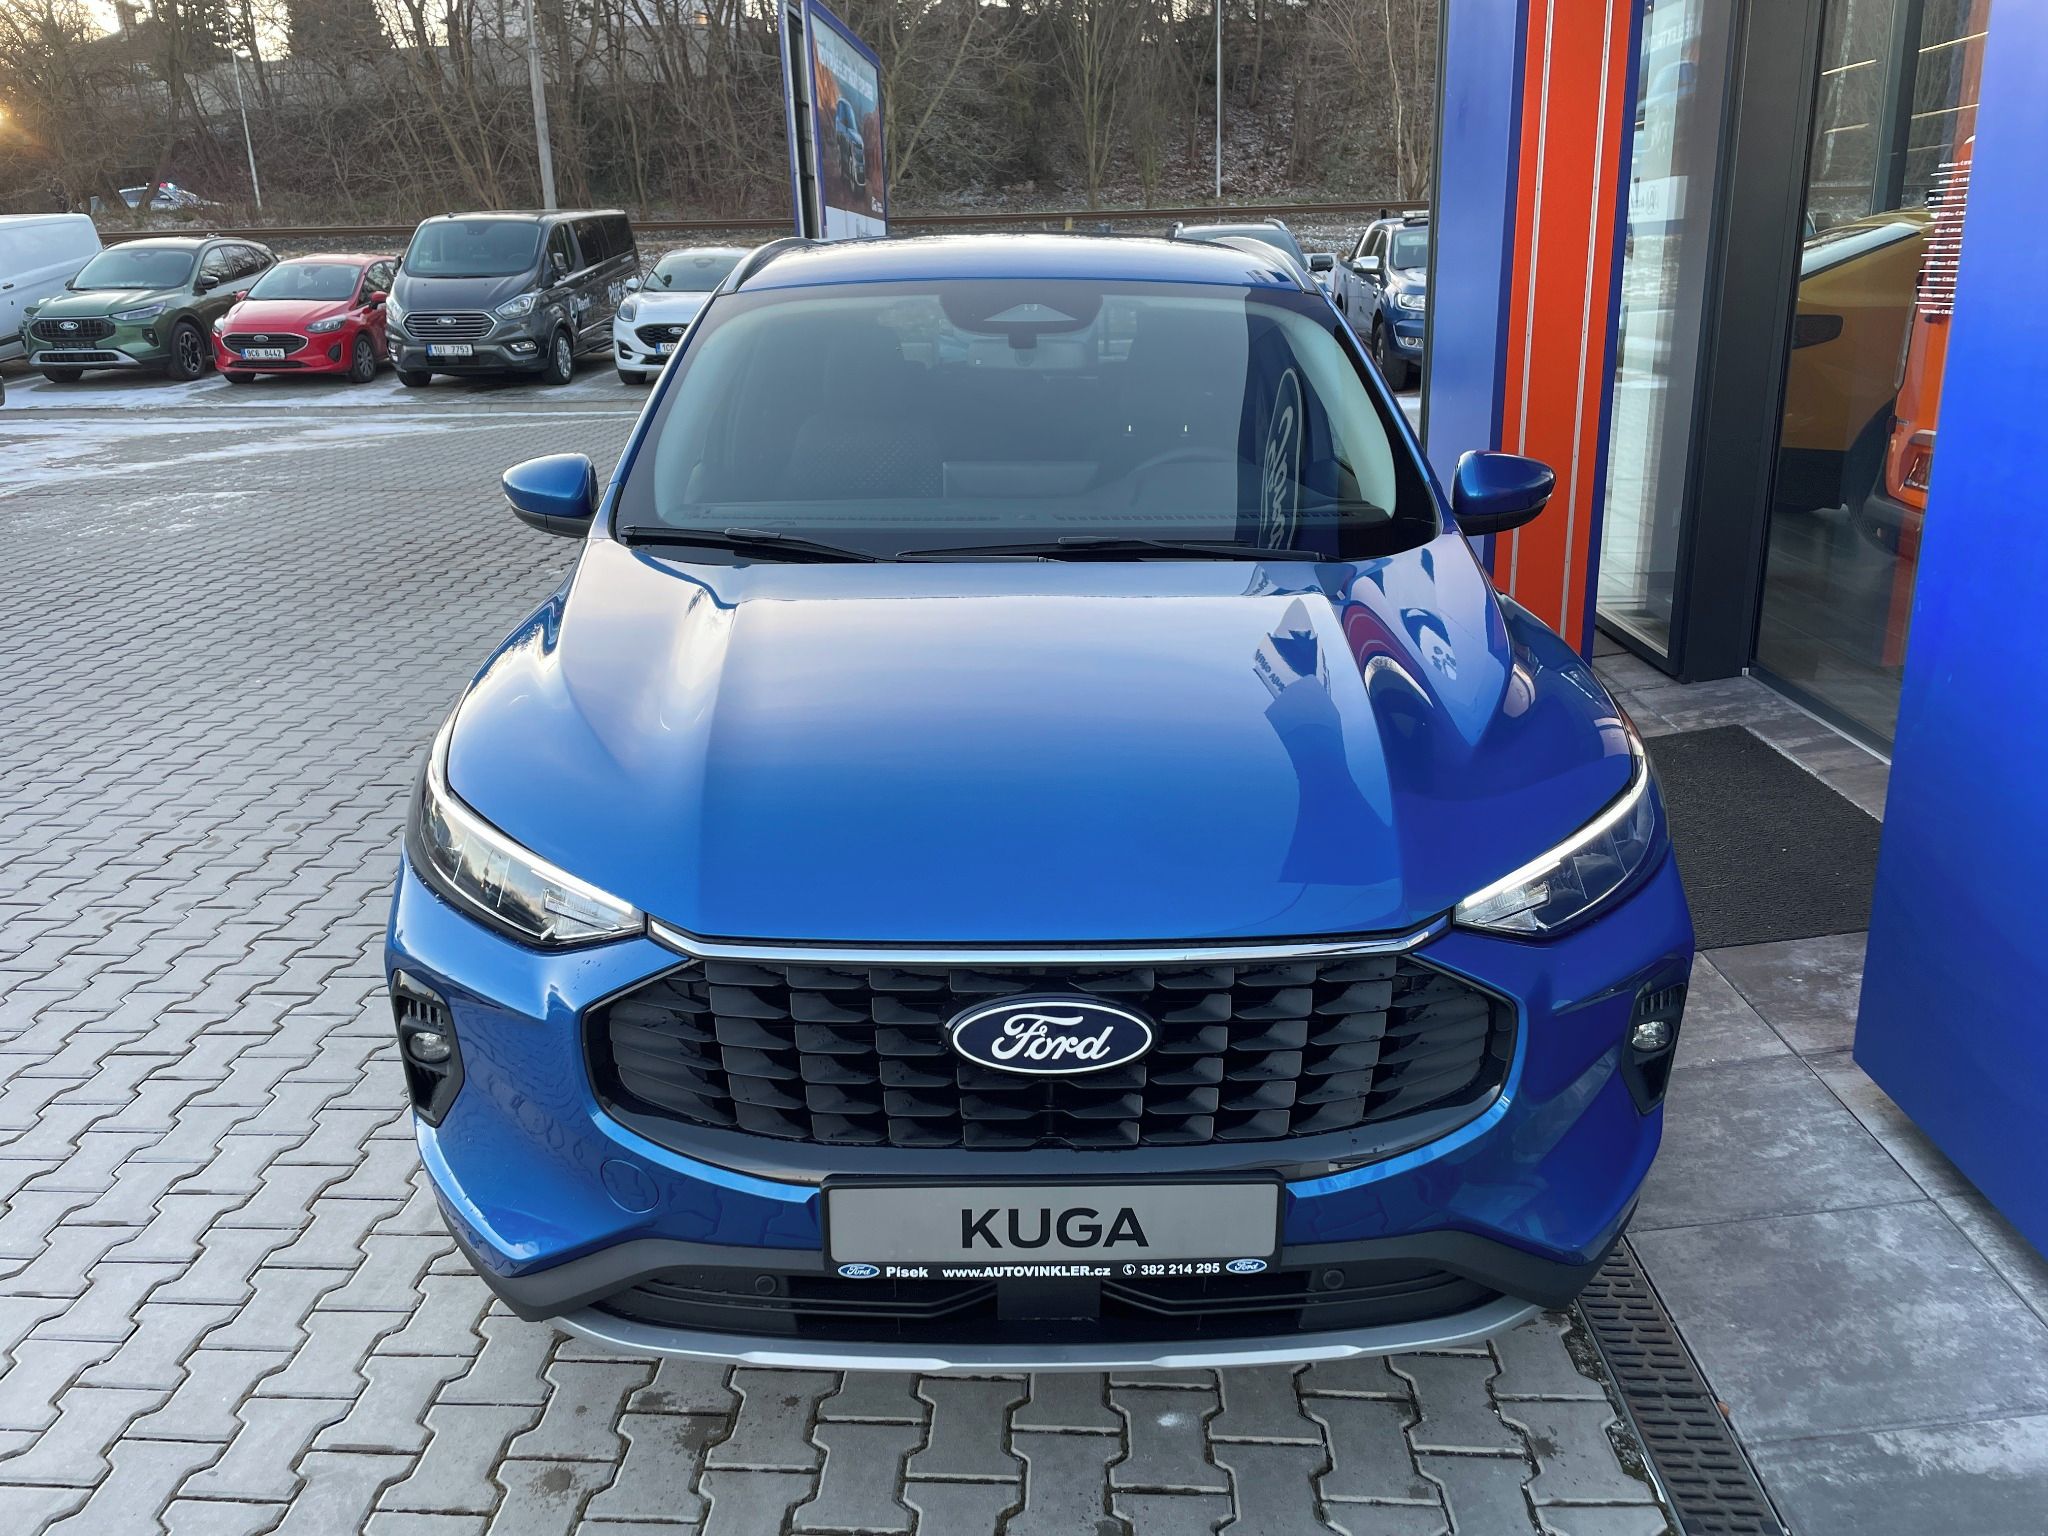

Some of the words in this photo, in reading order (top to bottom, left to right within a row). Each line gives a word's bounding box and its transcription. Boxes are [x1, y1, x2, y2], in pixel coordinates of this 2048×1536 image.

[991, 1013, 1114, 1060] Ford
[961, 1207, 1150, 1249] KUGA
[942, 1265, 1111, 1278] www.AUTOVINKLER.cz
[1140, 1264, 1165, 1275] 382
[1168, 1263, 1192, 1275] 214
[1195, 1262, 1220, 1274] 295
